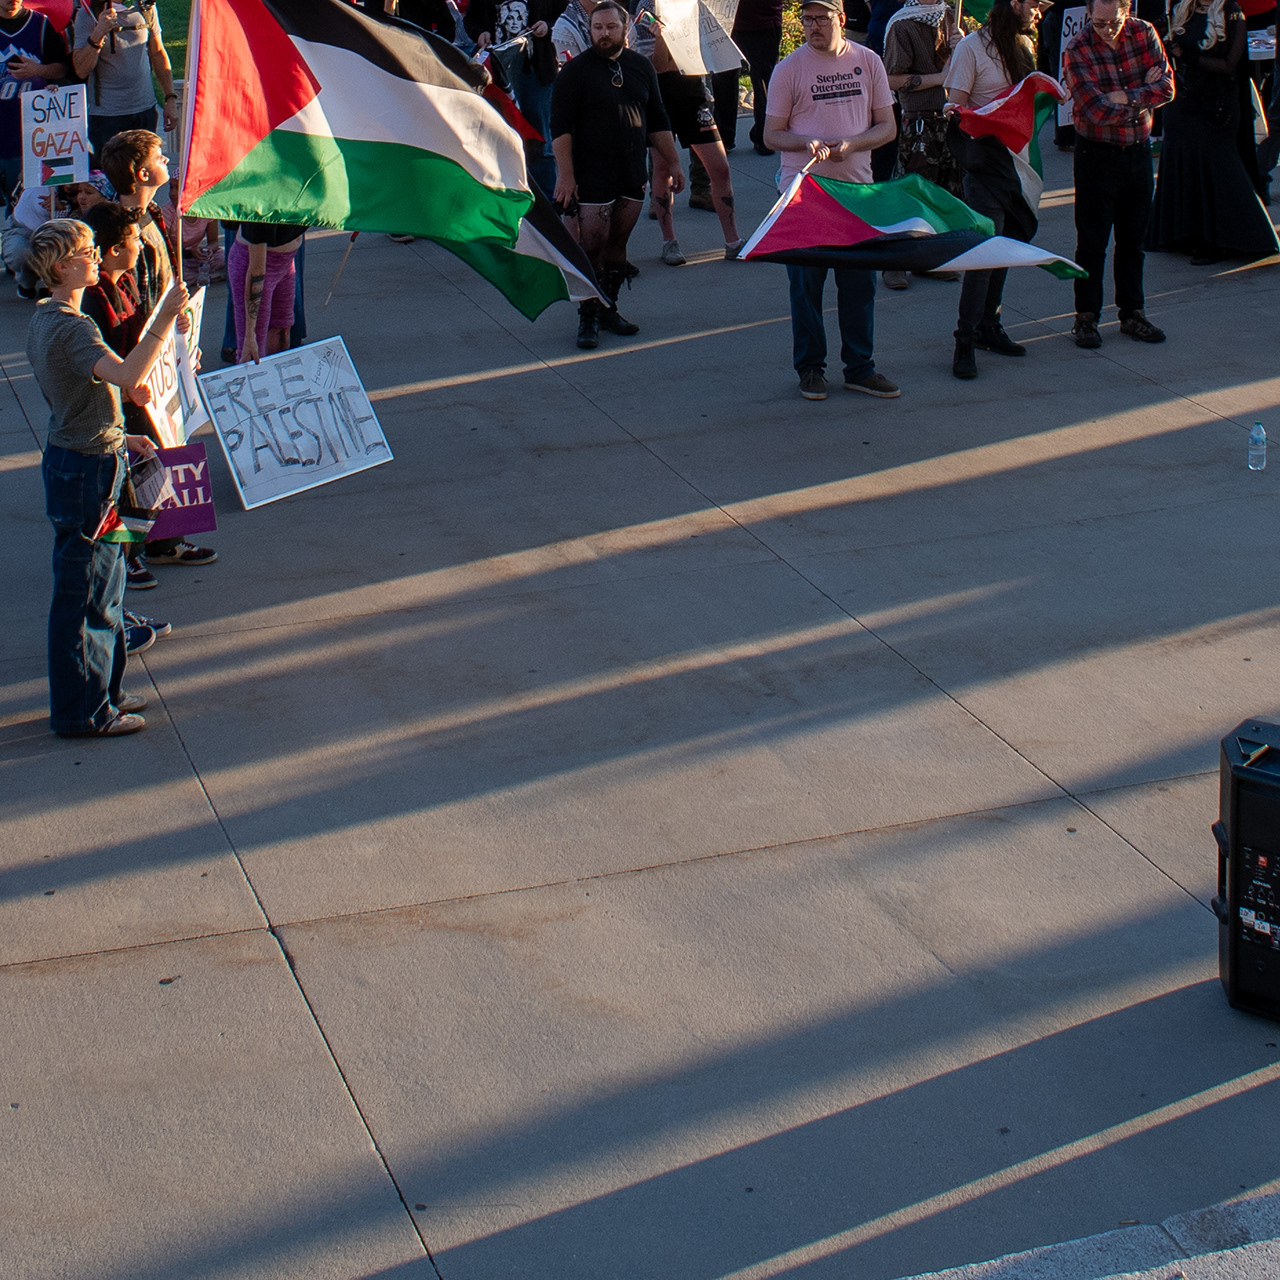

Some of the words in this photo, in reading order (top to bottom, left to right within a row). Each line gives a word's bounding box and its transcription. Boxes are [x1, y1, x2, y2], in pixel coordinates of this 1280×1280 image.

[811, 81, 861, 94] Otterstrom
[816, 72, 853, 84] Stephen
[32, 92, 81, 124] SAVE
[31, 127, 86, 157] GAZA
[201, 357, 312, 423] FREE
[223, 386, 387, 488] PALESTINE
